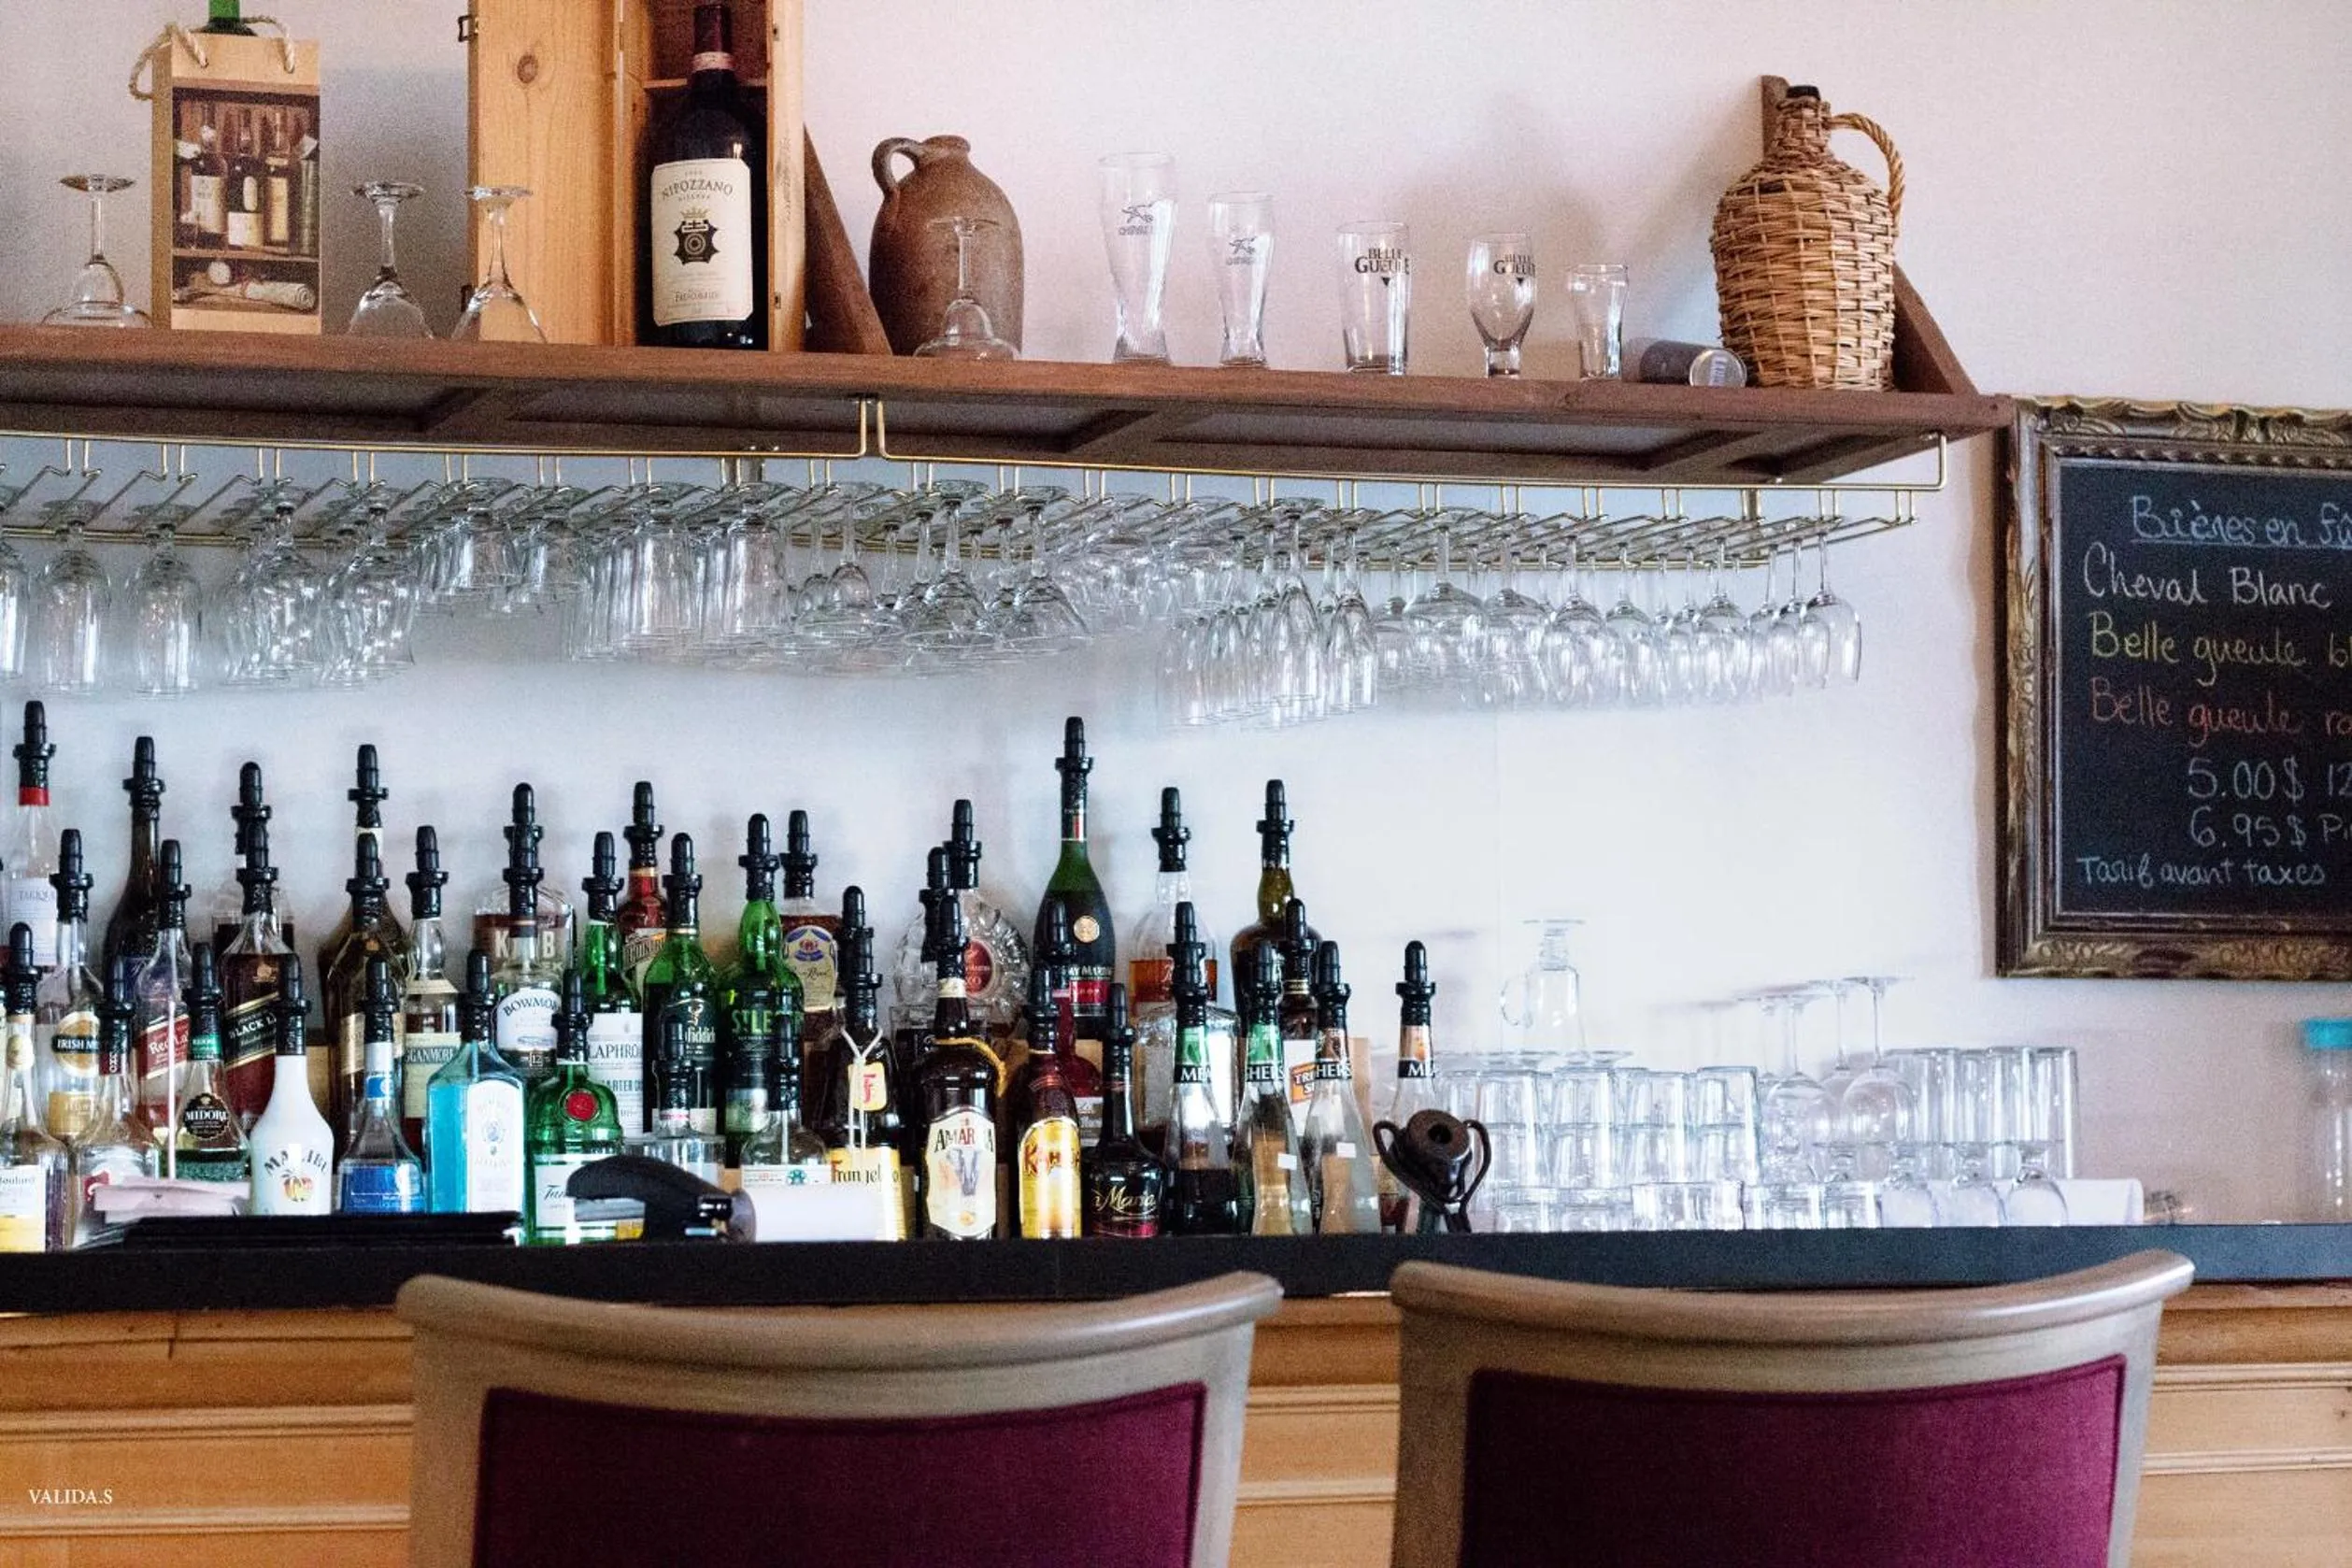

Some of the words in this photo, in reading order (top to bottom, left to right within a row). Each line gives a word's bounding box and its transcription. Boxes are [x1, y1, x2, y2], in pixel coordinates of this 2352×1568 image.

[661, 178, 734, 201] NIPOZZANO
[2130, 494, 2257, 545] Bières
[2265, 517, 2309, 546] en
[2084, 541, 2208, 606] Cheval
[2229, 566, 2332, 608] Blanc
[2088, 610, 2180, 664] Belle
[2193, 634, 2306, 687] gueule
[2089, 676, 2174, 730] Belle
[2188, 688, 2304, 748] gueule
[2318, 813, 2352, 844] Pi
[2076, 852, 2154, 890] Tarif
[2160, 857, 2235, 886] avant
[2243, 858, 2326, 886] taxes
[57, 1038, 84, 1048] IRISH
[588, 1043, 642, 1059] LAPHRO
[1316, 1064, 1352, 1078] HERS
[934, 1127, 994, 1153] AMARA
